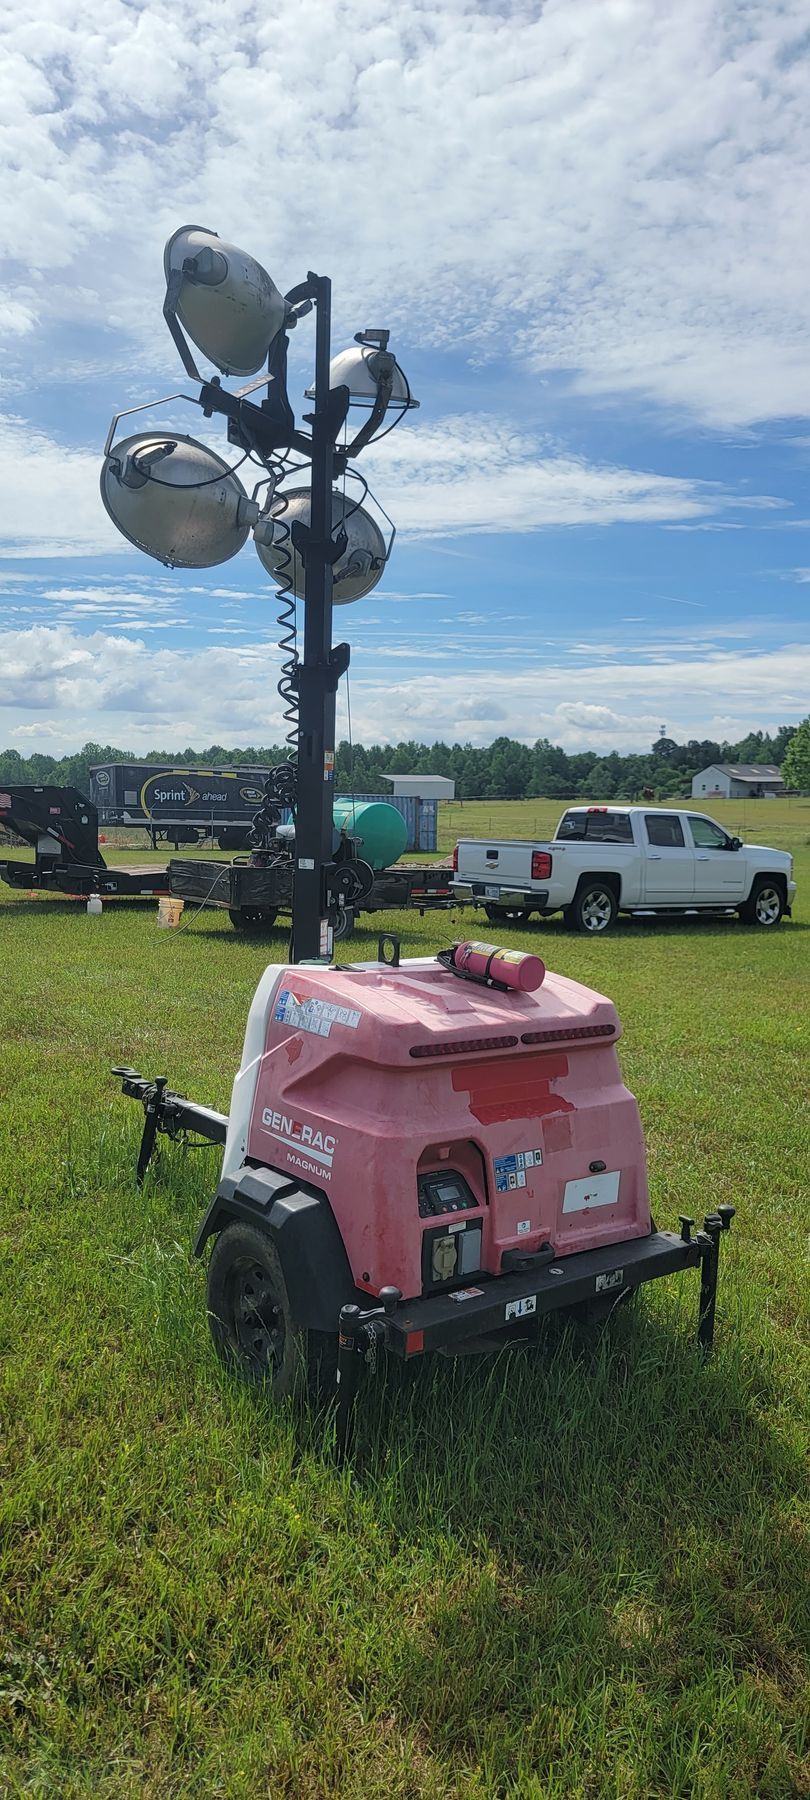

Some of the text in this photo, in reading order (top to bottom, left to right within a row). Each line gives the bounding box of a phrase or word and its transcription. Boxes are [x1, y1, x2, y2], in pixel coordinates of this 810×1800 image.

[154, 788, 227, 803] Sprint ahead
[262, 1107, 336, 1154] GENERAC
[286, 1153, 332, 1181] MAGNUM
